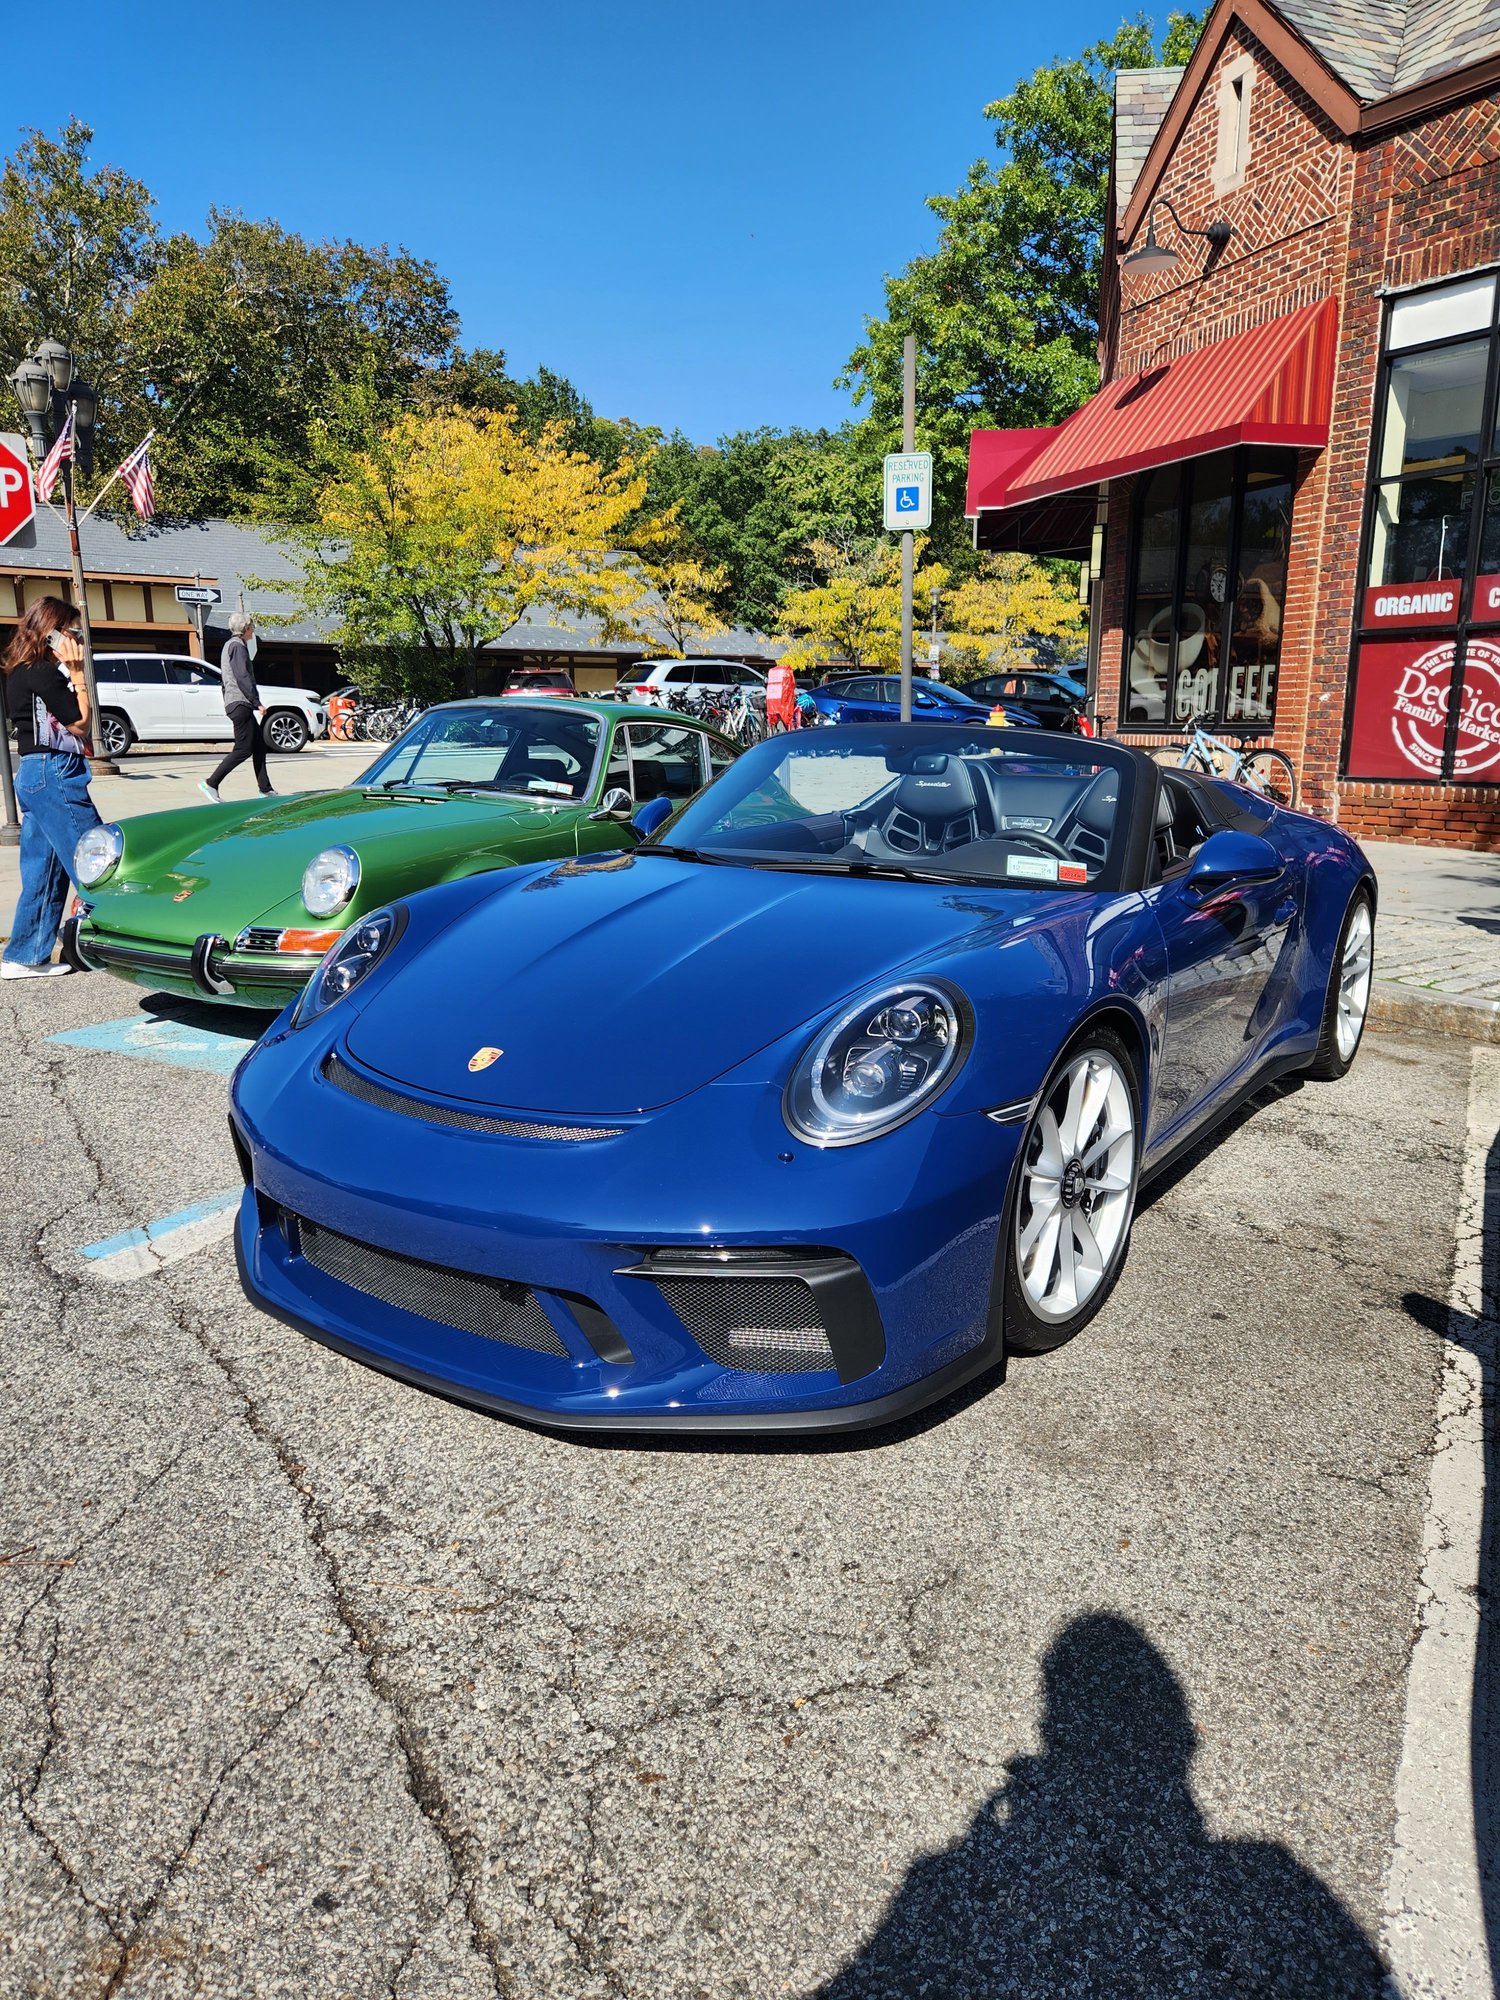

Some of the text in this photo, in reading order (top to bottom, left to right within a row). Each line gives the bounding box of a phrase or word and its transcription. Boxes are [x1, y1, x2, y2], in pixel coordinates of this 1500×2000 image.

[888, 460, 929, 471] RESERVED
[892, 473, 925, 483] PARKING
[181, 590, 194, 598] ONE
[1374, 592, 1453, 617] ORGANIC
[1421, 655, 1440, 671] THE
[1440, 648, 1476, 660] TAE
[1477, 649, 1491, 658] OF
[1393, 695, 1500, 745] Family Marke
[1409, 742, 1435, 764] SINCE
